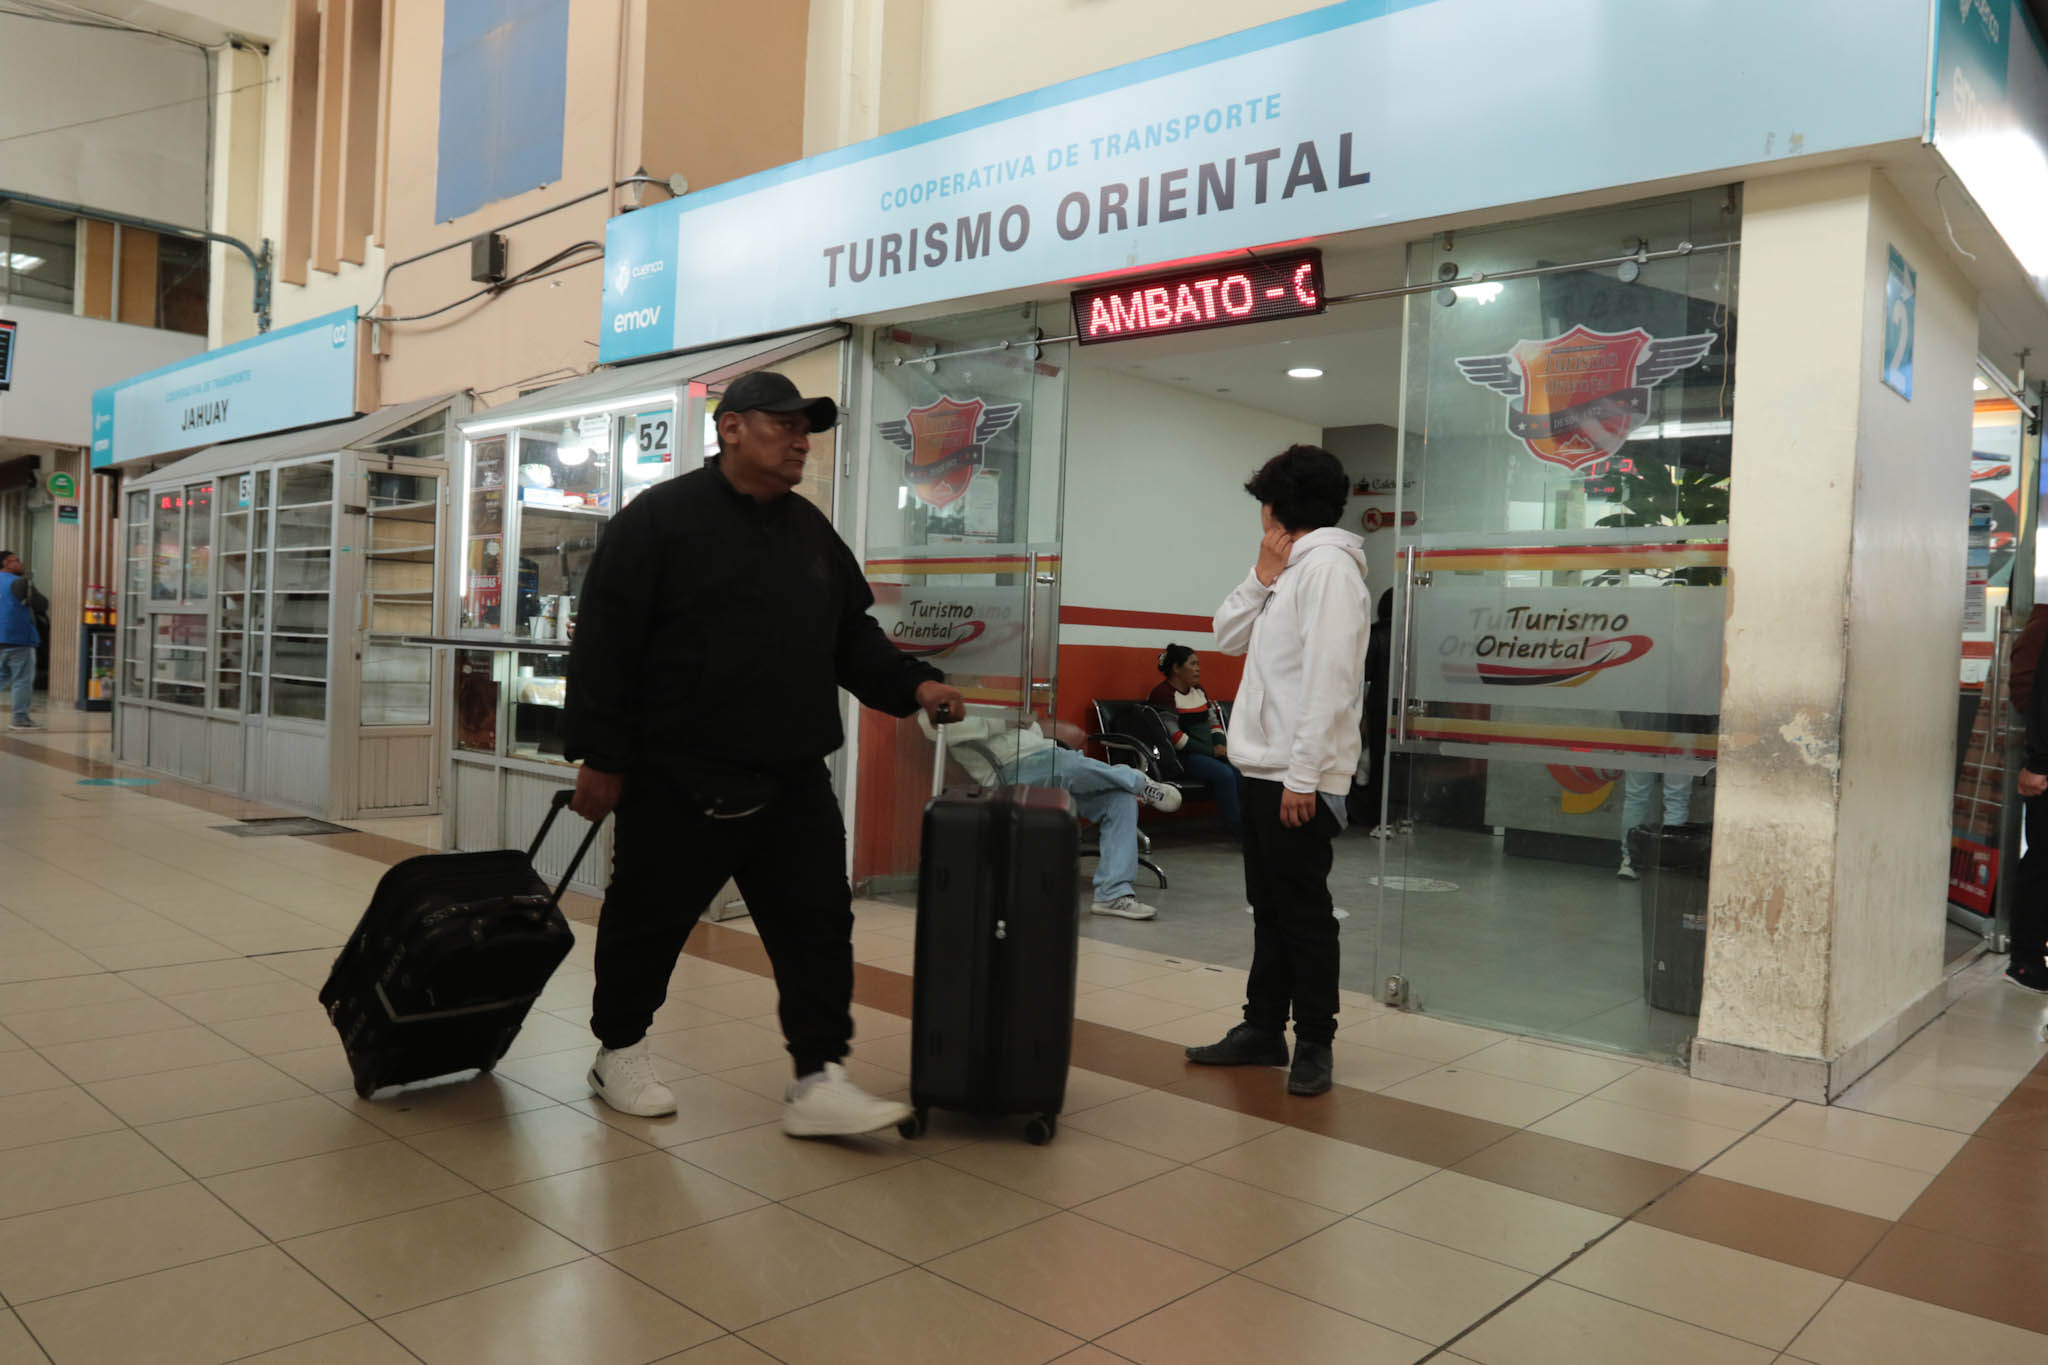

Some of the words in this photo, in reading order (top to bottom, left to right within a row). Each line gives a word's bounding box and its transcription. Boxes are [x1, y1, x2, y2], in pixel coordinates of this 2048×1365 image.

[880, 156, 1036, 212] COOPERATIVA
[1047, 144, 1079, 172] DE
[1090, 93, 1282, 160] TRANSPORTE
[823, 204, 1031, 288] TURISMO
[1056, 131, 1371, 241] ORIENTAL
[614, 305, 661, 334] emov
[1090, 275, 1253, 336] AMBATO
[181, 399, 230, 432] JAHUAY
[639, 420, 669, 452] 52
[909, 599, 974, 620] Turismo
[1507, 606, 1629, 632] Turismo
[893, 621, 953, 640] Oriental
[1475, 635, 1591, 661] Oriental
